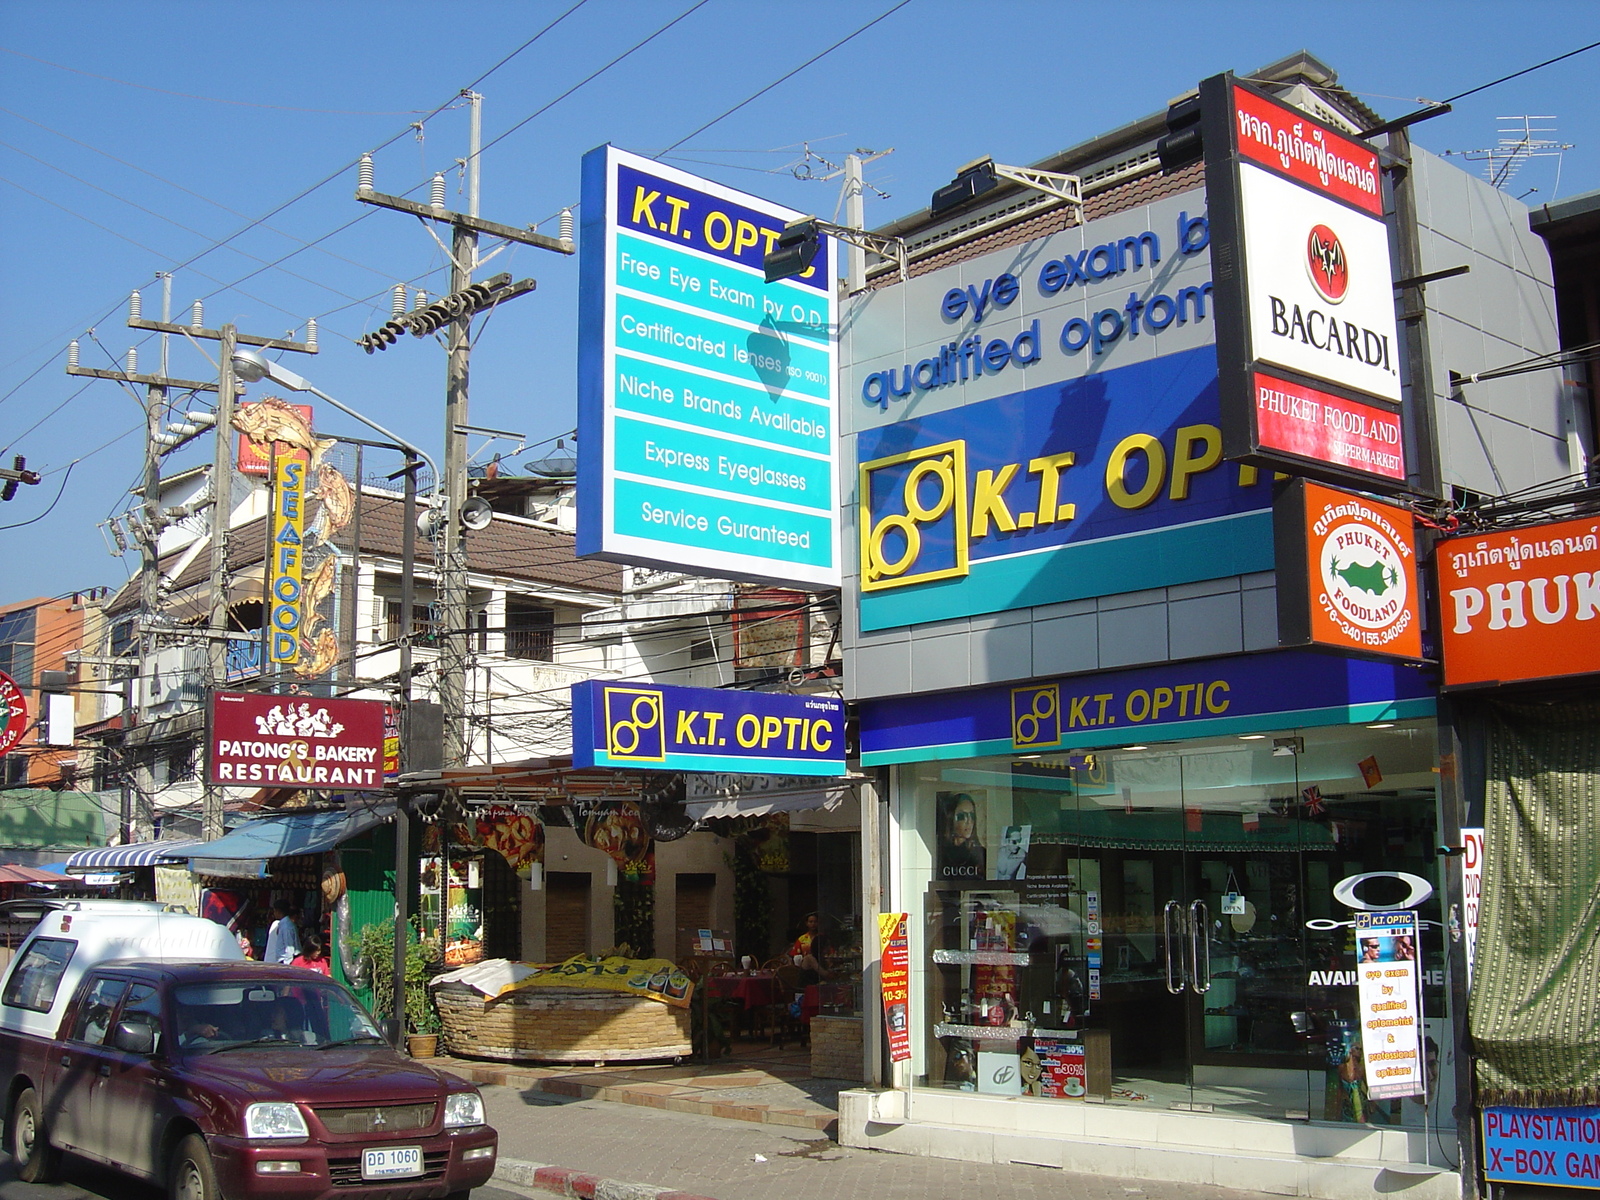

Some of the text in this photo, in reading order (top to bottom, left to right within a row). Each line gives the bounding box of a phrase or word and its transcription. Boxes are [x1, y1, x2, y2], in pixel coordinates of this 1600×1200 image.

[631, 185, 692, 240] K.T.
[621, 252, 661, 280] Free
[669, 267, 701, 293] Eye
[709, 279, 755, 309] Exam
[763, 295, 784, 319] by
[941, 272, 1019, 324] eye
[1039, 230, 1161, 293] exam
[620, 314, 726, 359] Certificated
[733, 343, 783, 373] lenses
[862, 318, 1041, 411] qualified
[620, 373, 827, 440] Niche Brands Available
[1258, 386, 1399, 445] PHUKET FOODLAND
[645, 440, 807, 491] Express Eyeglasses
[1333, 440, 1400, 471] SUPERMARKET
[970, 451, 1077, 539] K.T.
[641, 501, 811, 549] Service Guranteed
[272, 462, 304, 660] SEAFOOD
[1336, 531, 1391, 561] PHUKET
[1333, 586, 1399, 622] FOODLAND
[1068, 680, 1231, 728] K.T. OPTIC
[675, 710, 833, 752] K.T. OPTIC
[219, 740, 377, 763] PATONG'S BAKERY
[219, 763, 376, 785] RESTAURANT
[943, 867, 978, 876] GUCCI
[1372, 915, 1412, 925] K.T. OPTIC
[1366, 969, 1409, 979] eye exam
[1382, 985, 1393, 995] by
[1371, 1000, 1407, 1012] qualified
[1367, 1016, 1413, 1029] optometrist
[1387, 1034, 1395, 1043] &
[1368, 1048, 1415, 1063] professional
[1488, 1113, 1600, 1144] PLAYSTATIO
[391, 1150, 418, 1164] 1060
[1490, 1147, 1557, 1176] X-BOX
